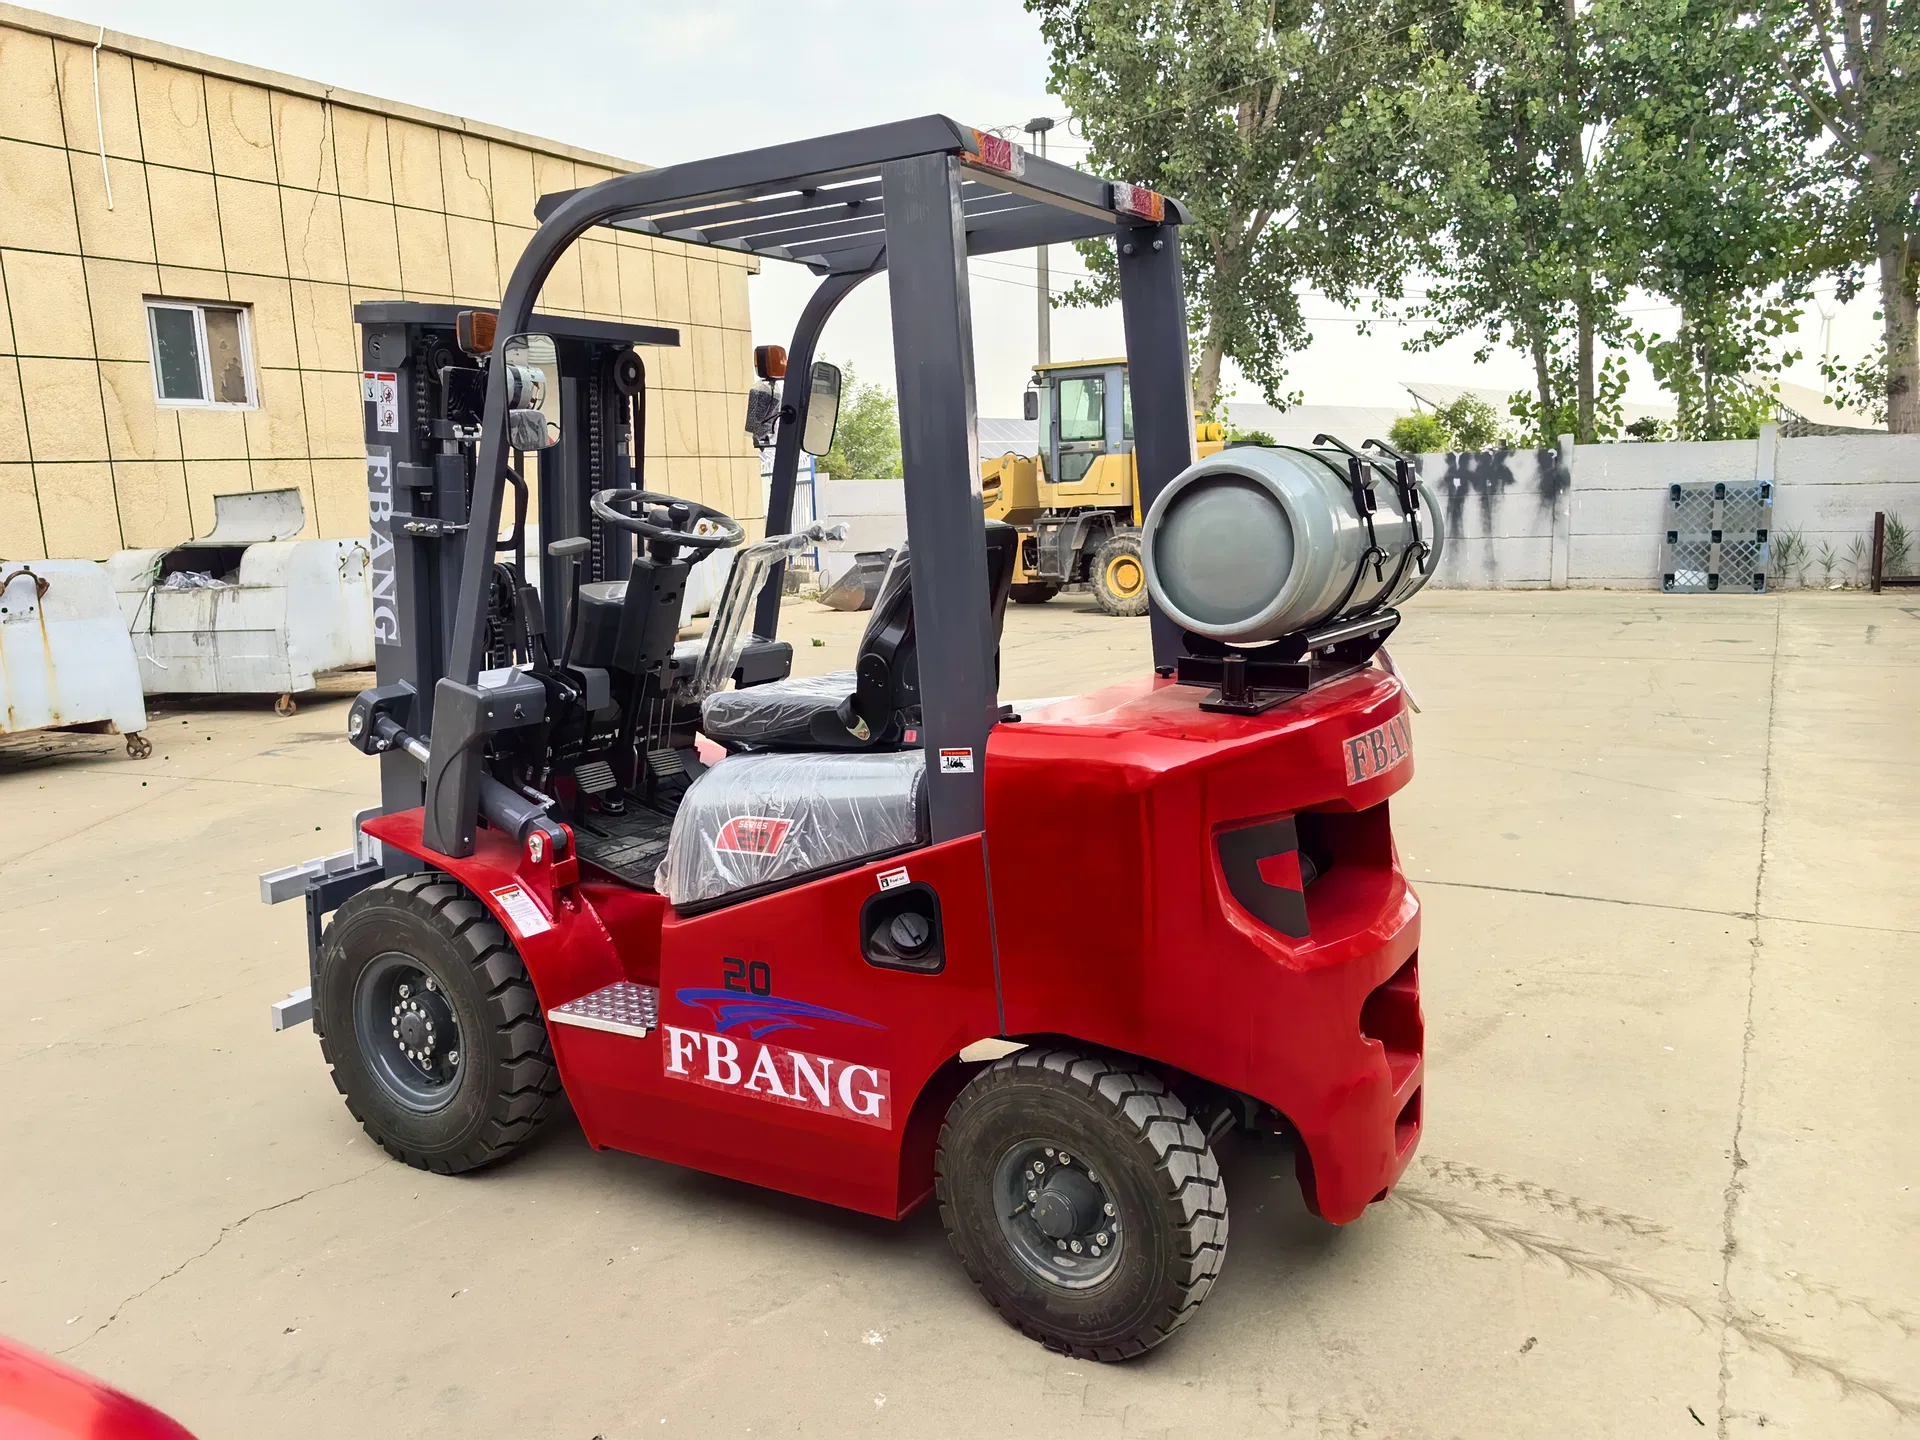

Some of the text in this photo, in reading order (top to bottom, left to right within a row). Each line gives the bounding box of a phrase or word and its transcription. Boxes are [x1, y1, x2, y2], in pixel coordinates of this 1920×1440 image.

[367, 451, 398, 645] FBANG
[738, 820, 769, 830] SERIES
[723, 956, 771, 997] 20
[664, 1025, 886, 1119] FBANG
